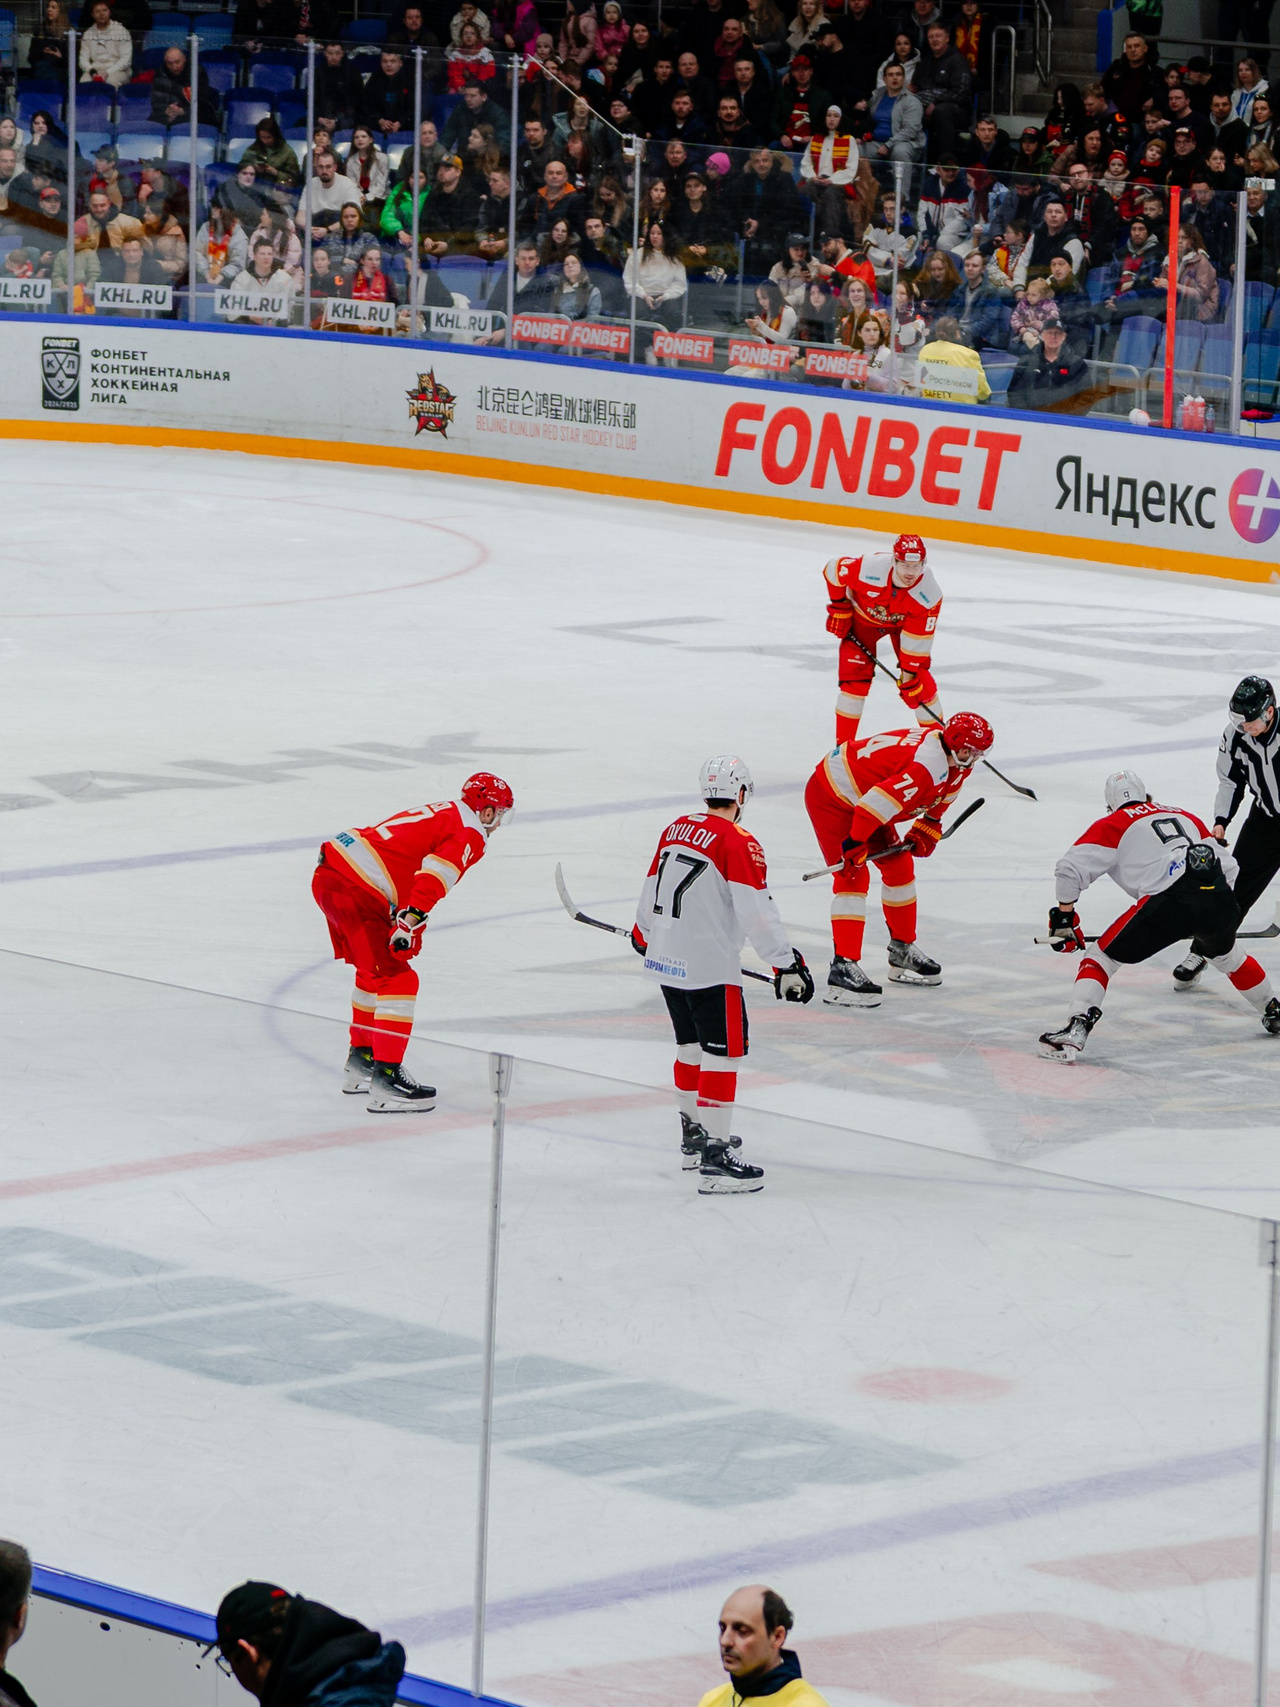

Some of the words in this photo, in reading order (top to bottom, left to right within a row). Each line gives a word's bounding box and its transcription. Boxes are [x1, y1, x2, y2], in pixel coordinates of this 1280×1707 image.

[0, 282, 45, 299] L.RU
[99, 287, 167, 305] KHL.RU
[219, 294, 283, 313] KHL.RU
[331, 304, 391, 323] KHL.RU
[435, 311, 488, 332] KHL.RU
[512, 317, 570, 341] FONBET
[43, 338, 78, 349] FONBET
[571, 325, 629, 350] FONBET
[654, 333, 713, 358] FONBET
[90, 349, 148, 362] ФОНБЕТ
[728, 342, 790, 368] FONBET
[806, 352, 866, 377] FONBET
[90, 363, 231, 382] КОНТИНЕНТАЛЬНАЯ
[91, 378, 178, 393] ХОККЕЙНАЯ
[924, 388, 952, 399] SAFETY
[90, 393, 127, 405] ЛИГА
[477, 384, 637, 430] 北京昆仑鸿星冰球俱乐部
[476, 414, 508, 434] BEIJING
[509, 418, 541, 438] KUNLUN
[543, 423, 557, 441] RED
[560, 425, 581, 443] STAR
[582, 429, 614, 448] HOCKEY
[616, 433, 637, 451] CLUB
[714, 401, 1022, 511] FONBET
[1055, 455, 1217, 529] Яндекс
[708, 787, 718, 798] 17
[893, 773, 919, 803] 74
[652, 851, 710, 919] 17
